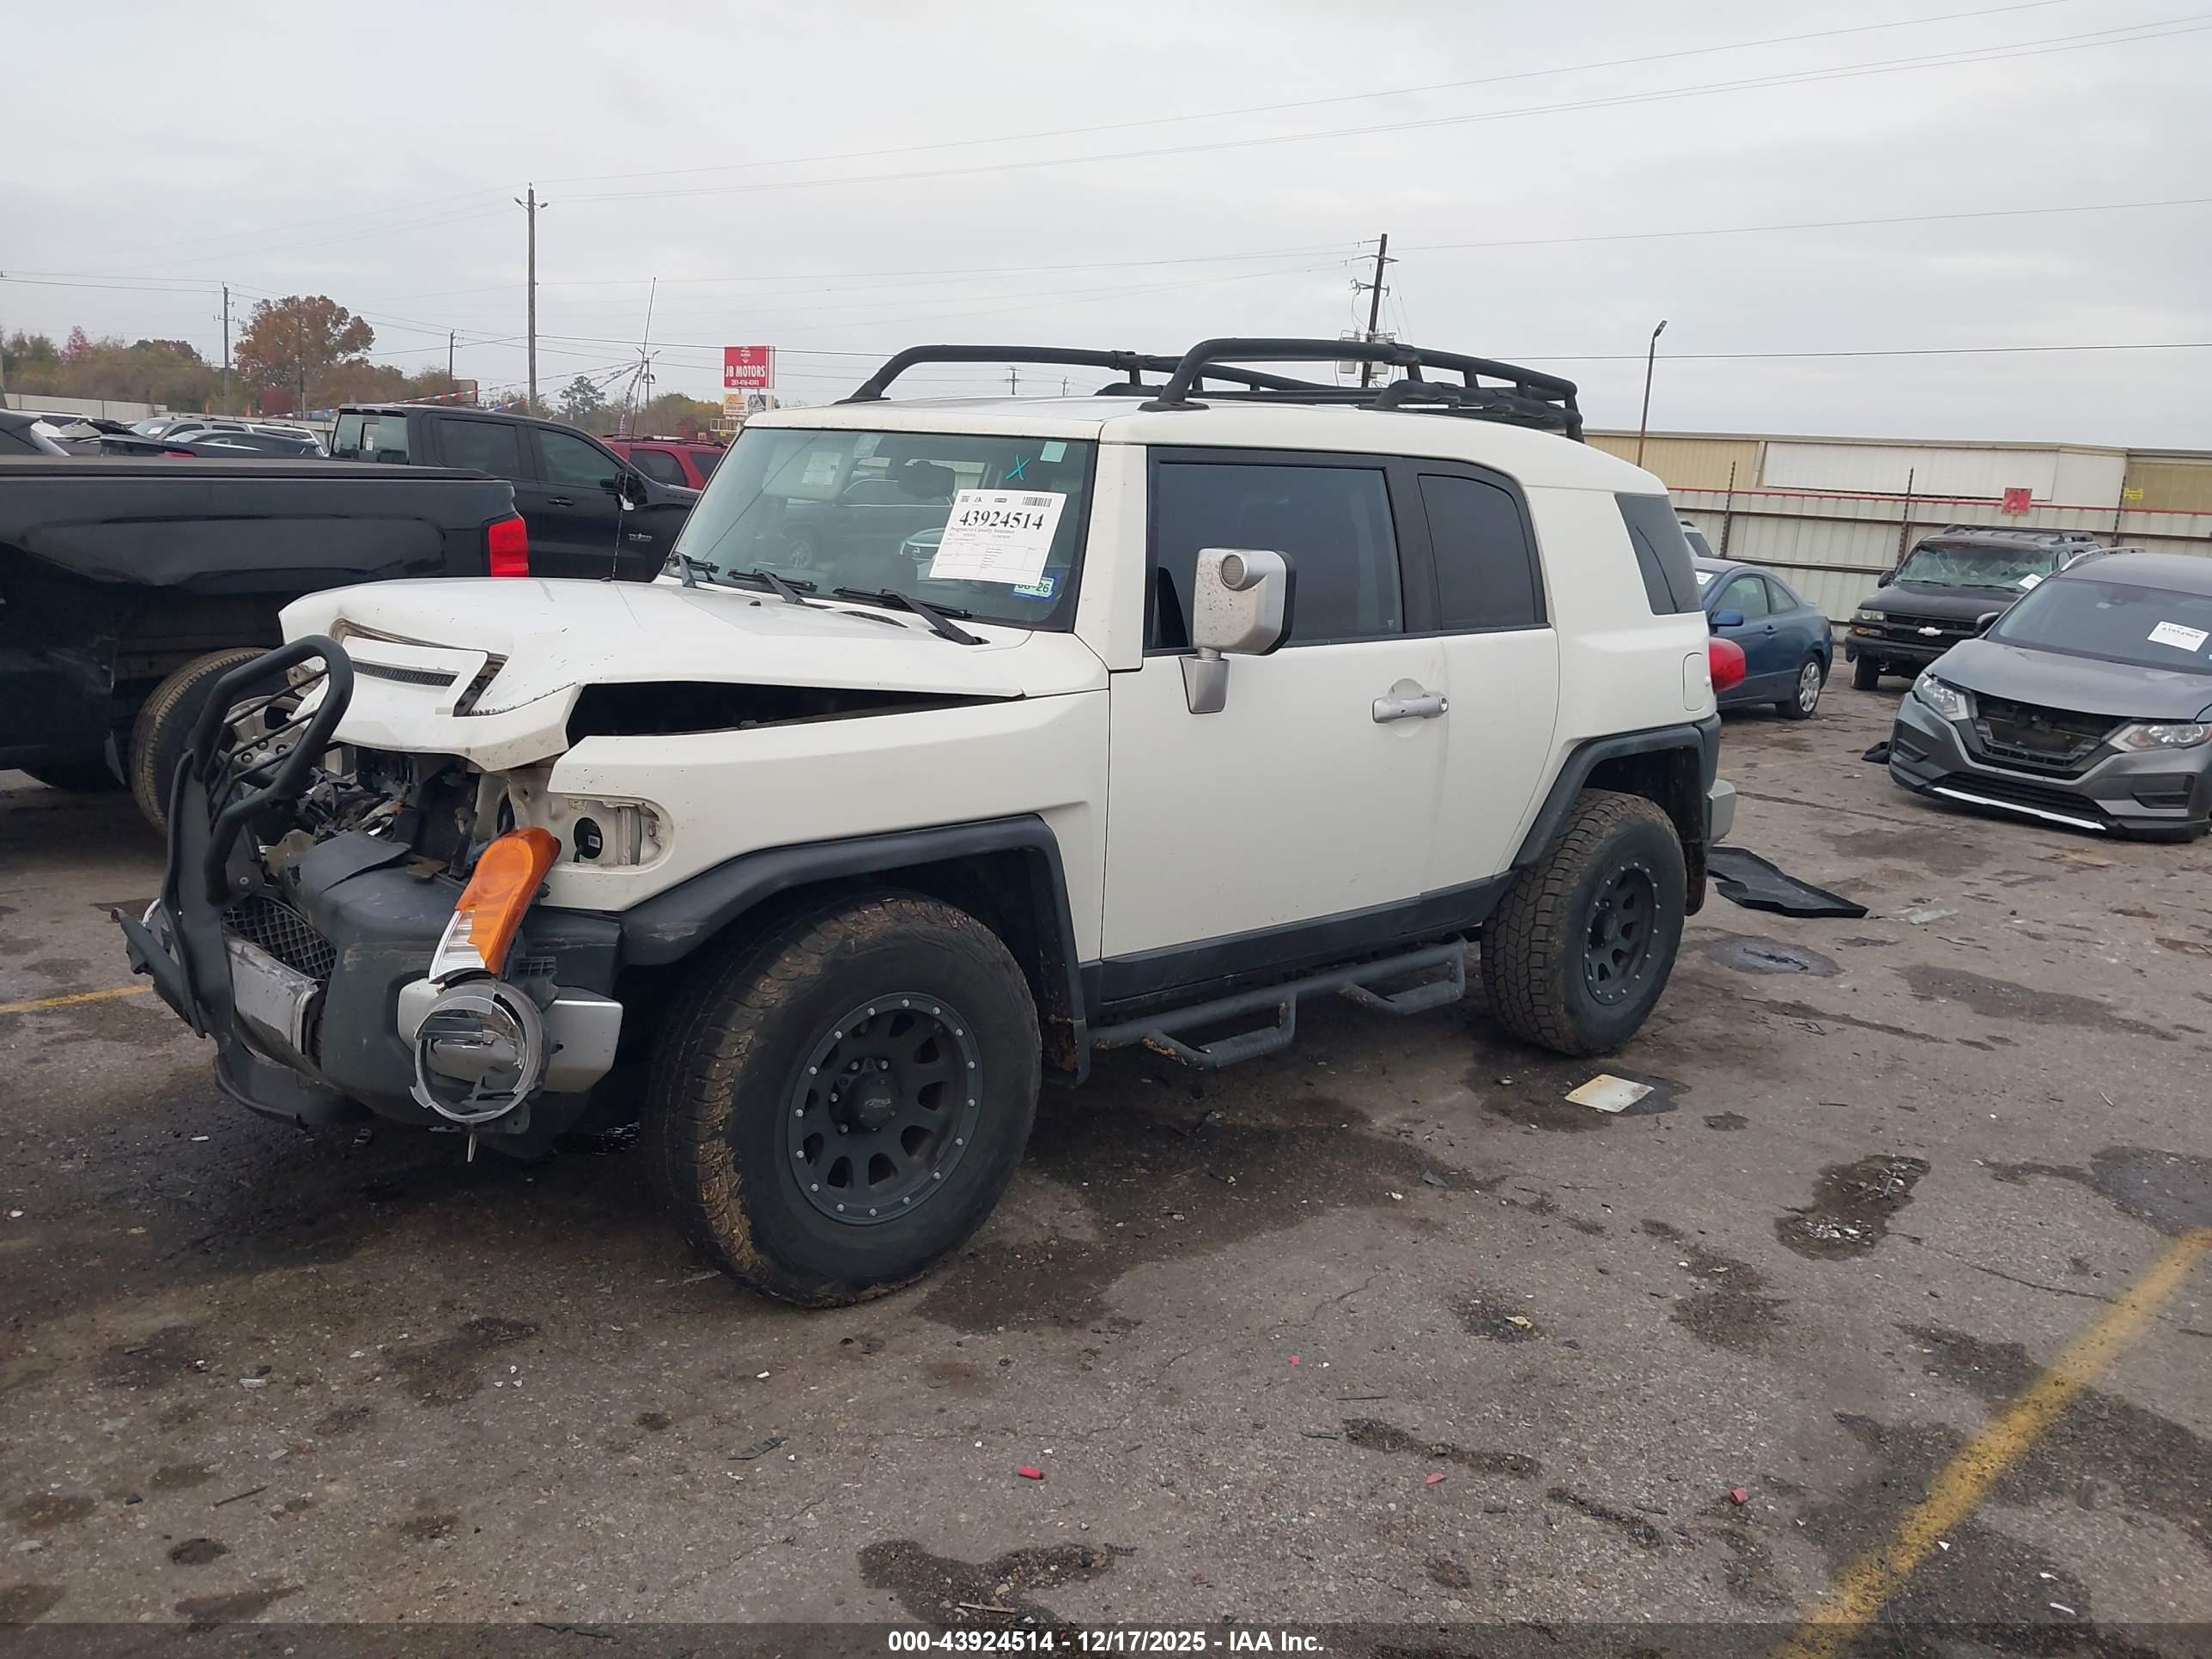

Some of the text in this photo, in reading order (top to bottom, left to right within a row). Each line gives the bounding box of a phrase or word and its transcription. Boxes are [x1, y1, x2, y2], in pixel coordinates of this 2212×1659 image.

[726, 365, 766, 378] JB MOTORS
[959, 509, 1044, 530] 43924514
